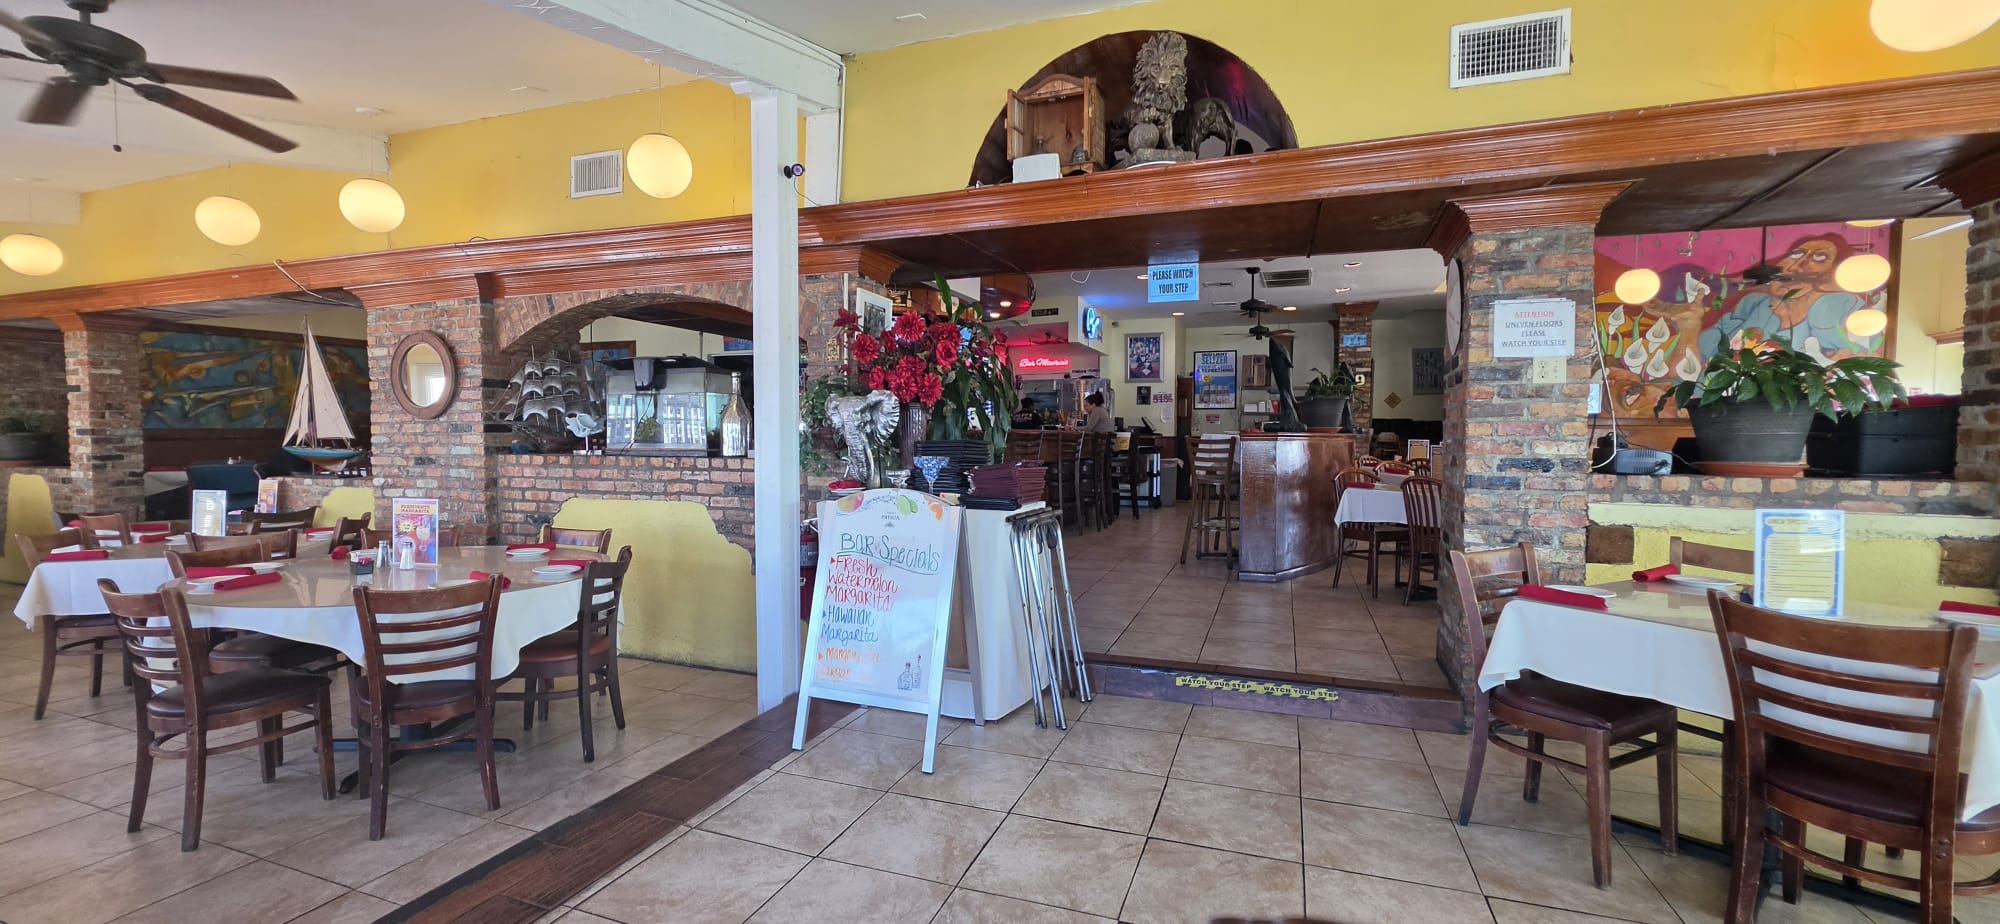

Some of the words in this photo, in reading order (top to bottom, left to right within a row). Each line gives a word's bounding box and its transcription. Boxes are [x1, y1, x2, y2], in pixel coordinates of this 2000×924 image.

[1152, 269, 1172, 281] PLEASE
[1172, 268, 1194, 279] WATCH
[1158, 283, 1174, 294] YOUR
[1174, 282, 1189, 293] STEP
[1514, 310, 1555, 319] ATTENTION
[1535, 320, 1563, 328] FLOORS
[1521, 329, 1546, 337] PLEASE
[1528, 339, 1549, 347] YOUR
[879, 534, 941, 573] Specials
[1181, 677, 1207, 686] WATCH
[1209, 680, 1230, 688] YOUR
[1232, 682, 1251, 690] STEP
[1263, 685, 1291, 694] WATCH
[1294, 688, 1316, 696] YOUR
[1318, 690, 1338, 699] STEP
